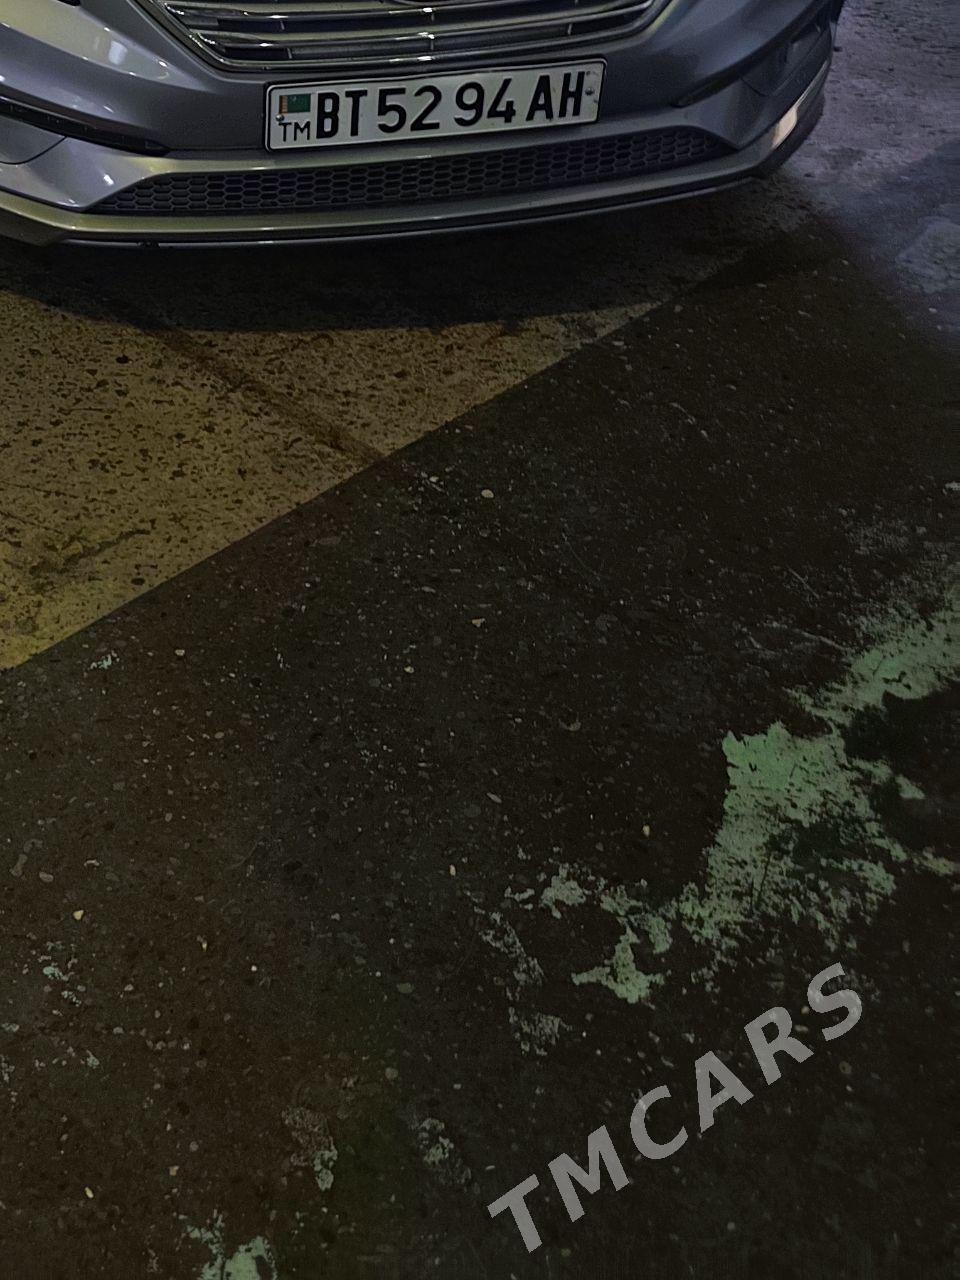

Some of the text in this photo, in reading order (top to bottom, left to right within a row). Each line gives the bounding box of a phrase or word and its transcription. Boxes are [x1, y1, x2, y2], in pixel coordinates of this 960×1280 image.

[315, 70, 586, 140] BT 52 94 AH
[278, 120, 311, 142] TM
